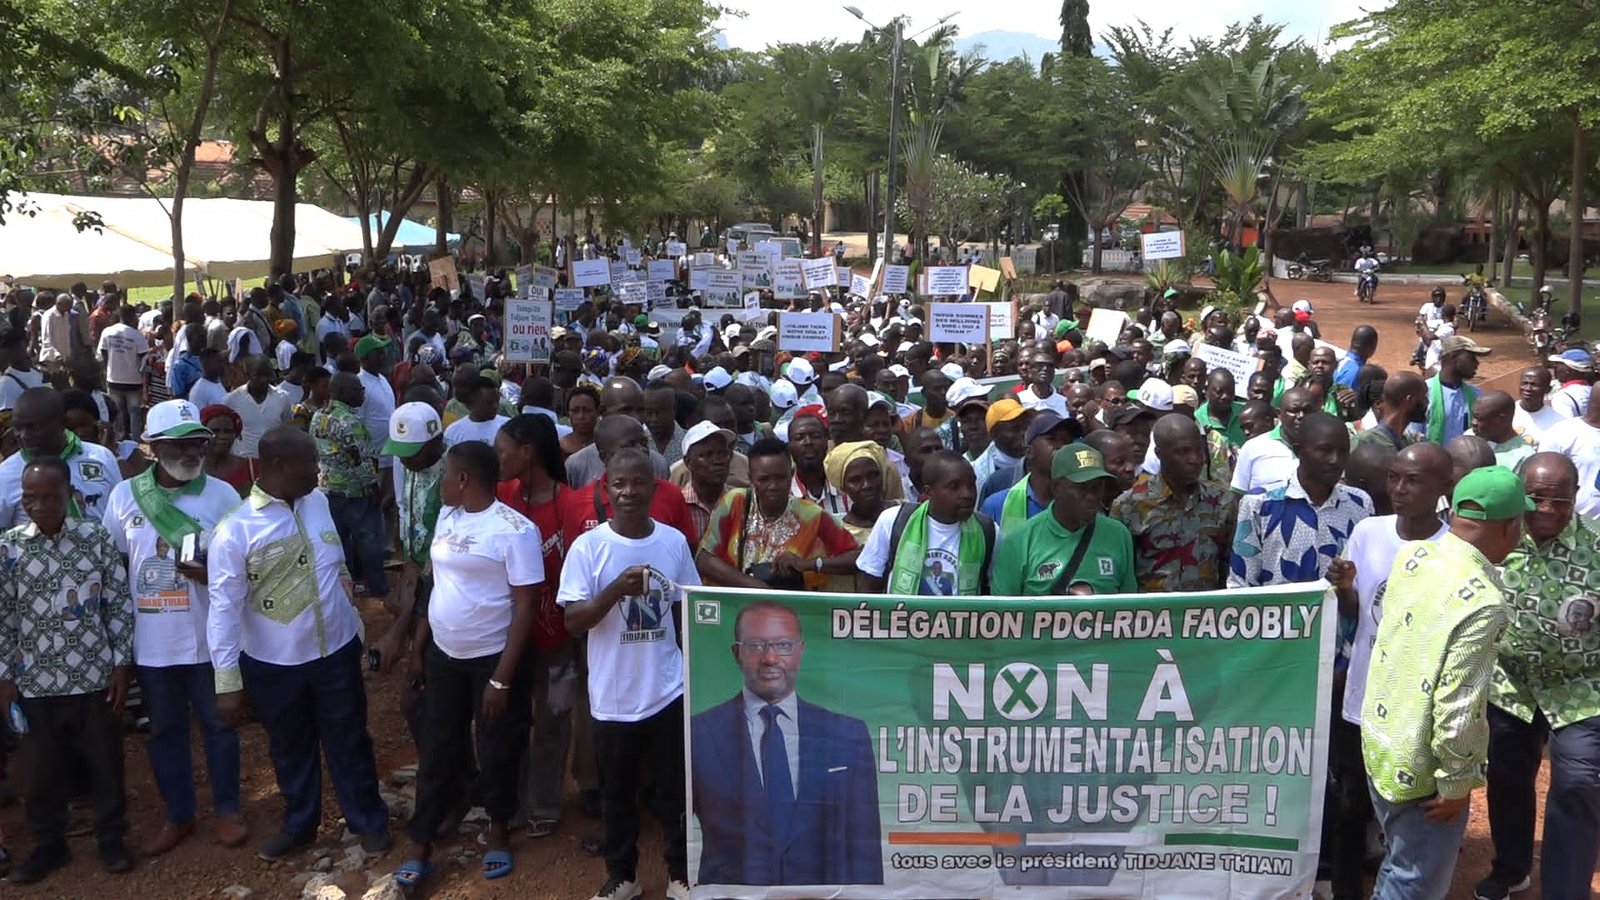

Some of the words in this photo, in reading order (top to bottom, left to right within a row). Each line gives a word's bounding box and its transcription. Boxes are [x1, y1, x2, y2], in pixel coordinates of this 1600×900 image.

[531, 286, 544, 295] OUI
[513, 324, 525, 334] ou
[528, 322, 545, 335] rien
[832, 602, 1024, 640] DÉLÉGATION
[1032, 608, 1173, 640] PDCI-RDA
[1181, 604, 1321, 639] FACOBLY
[932, 661, 1109, 721] NON
[1136, 648, 1195, 721] À
[879, 726, 1312, 776] L'INSTRUMENTALISATION
[898, 784, 958, 823] DE
[973, 784, 1033, 823] LA
[1047, 784, 1250, 824] JUSTICE
[1264, 785, 1278, 826] !
[891, 853, 938, 869] tous
[941, 855, 990, 869] avec
[996, 853, 1015, 869] le
[1020, 852, 1118, 872] président
[1123, 853, 1215, 870] TIDJANE
[1220, 855, 1292, 876] THIAM
